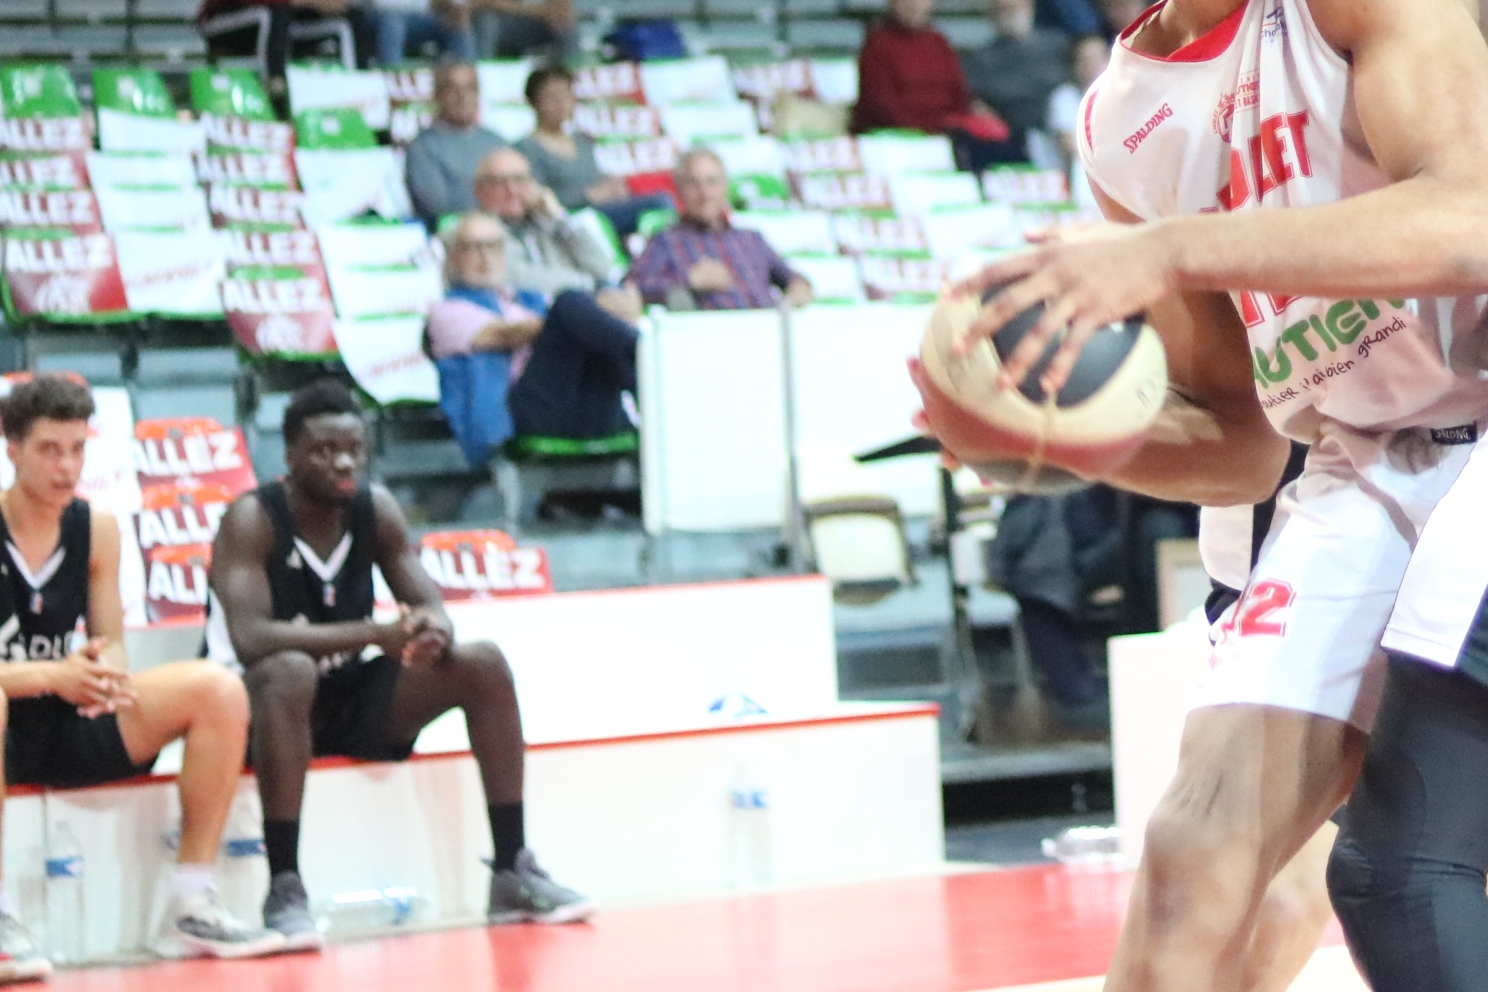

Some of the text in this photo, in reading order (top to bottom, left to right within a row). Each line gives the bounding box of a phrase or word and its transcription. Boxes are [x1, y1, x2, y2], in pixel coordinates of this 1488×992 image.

[1123, 103, 1173, 154] SPALDING
[5, 234, 114, 272] ALLEZ
[222, 278, 322, 313] ALLEZ
